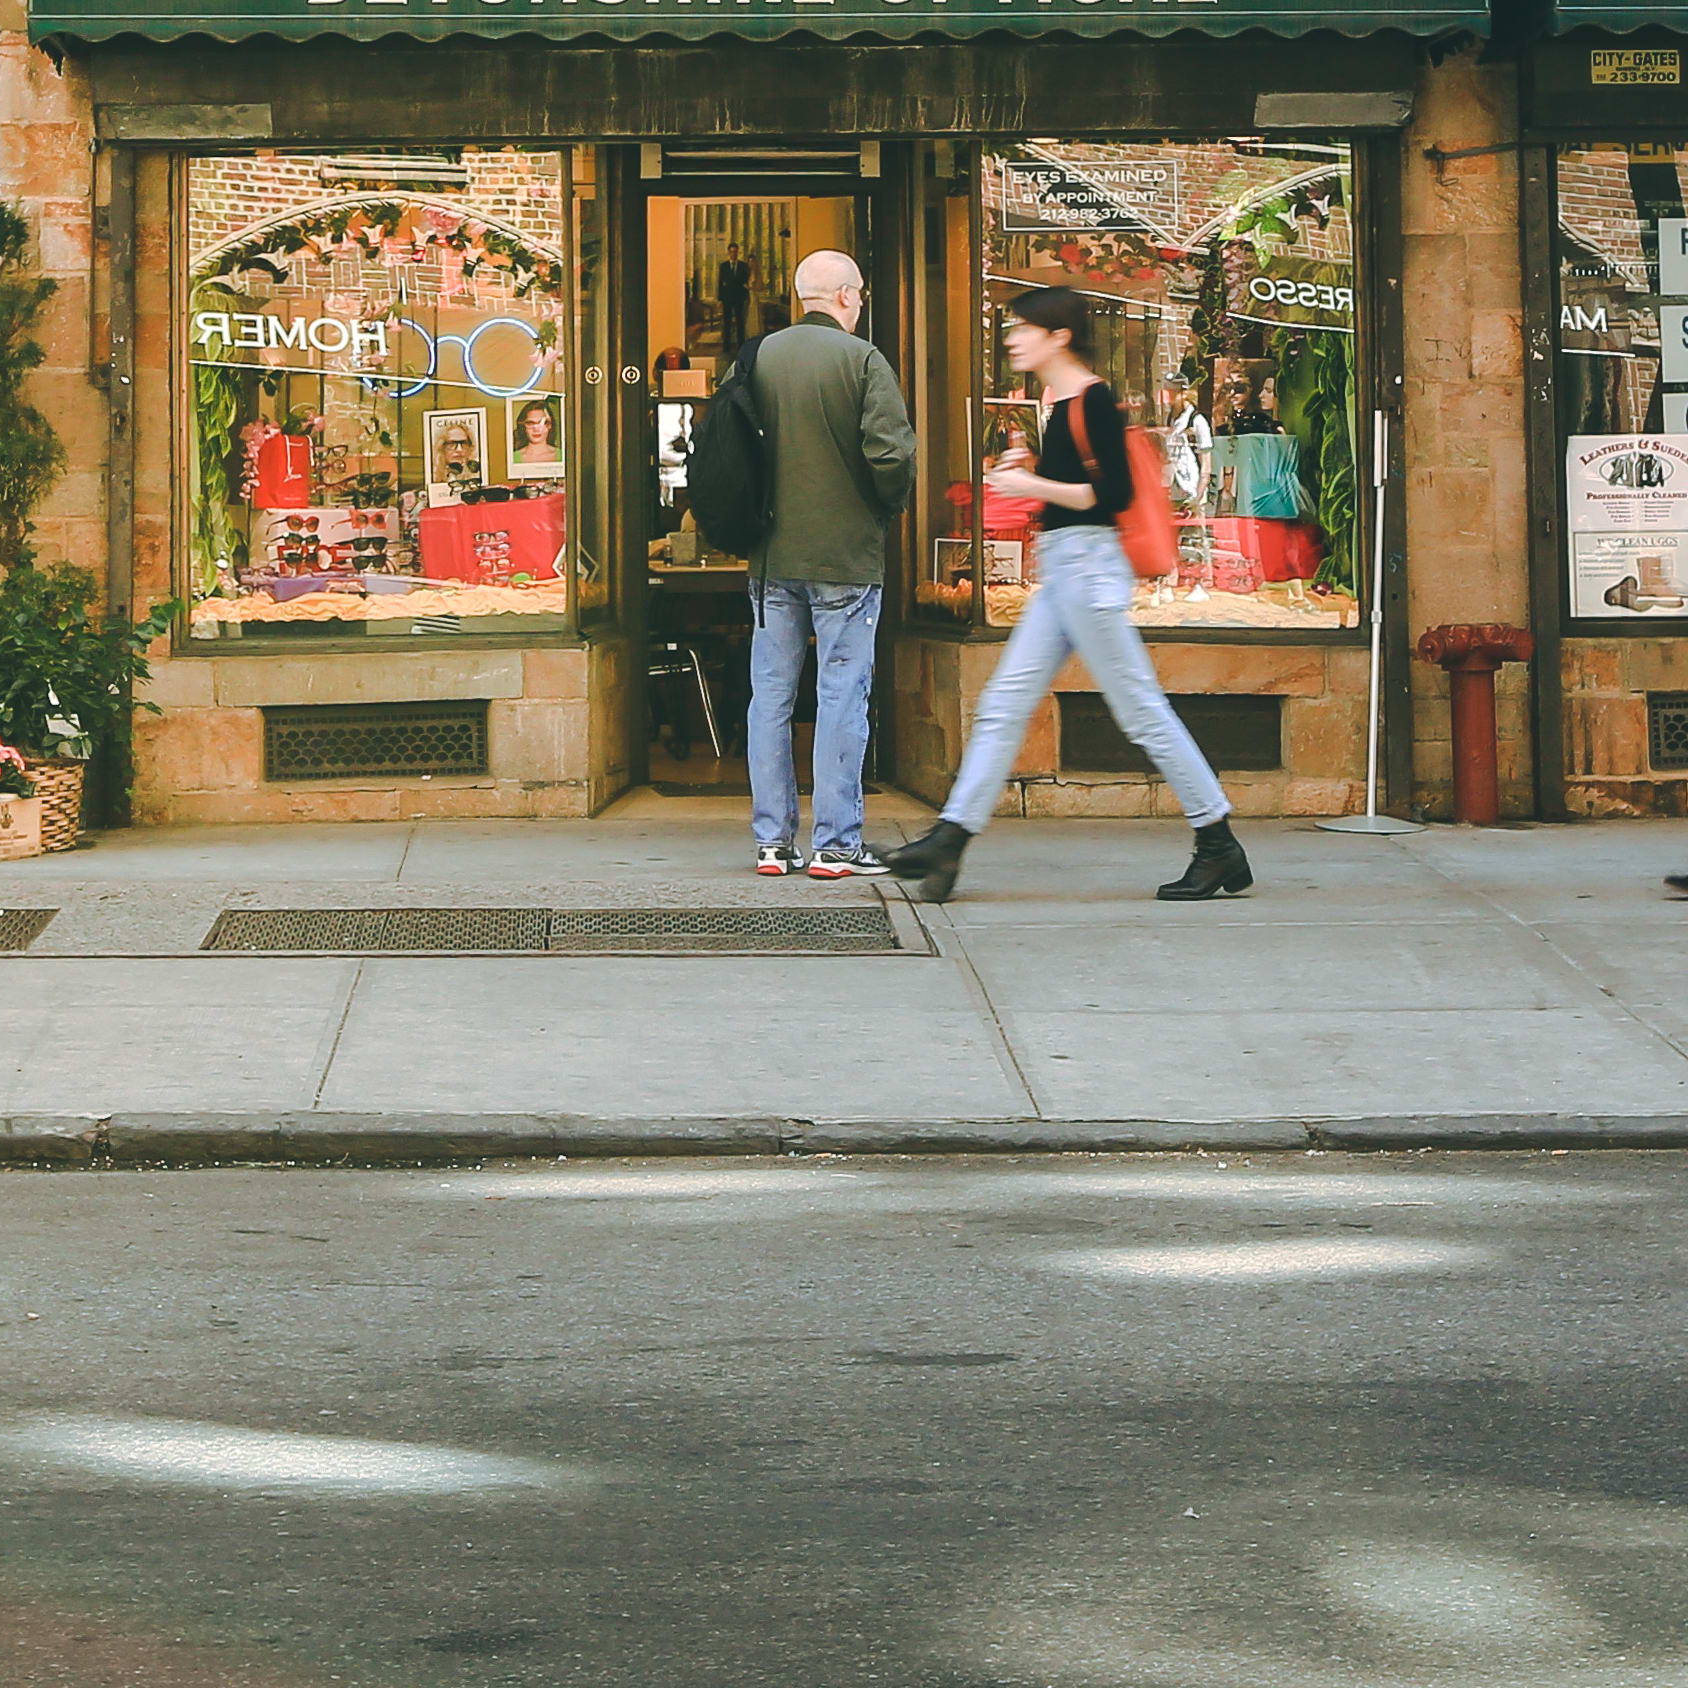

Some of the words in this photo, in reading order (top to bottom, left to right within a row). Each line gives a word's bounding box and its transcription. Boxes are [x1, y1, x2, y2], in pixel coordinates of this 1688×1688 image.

[1012, 171, 1061, 184] EYES
[1065, 169, 1168, 183] EXAMINED
[1023, 192, 1044, 204] BY
[1045, 191, 1158, 204] APPOINTMENT
[1579, 442, 1635, 465] LEATHERS
[1638, 439, 1650, 450] &
